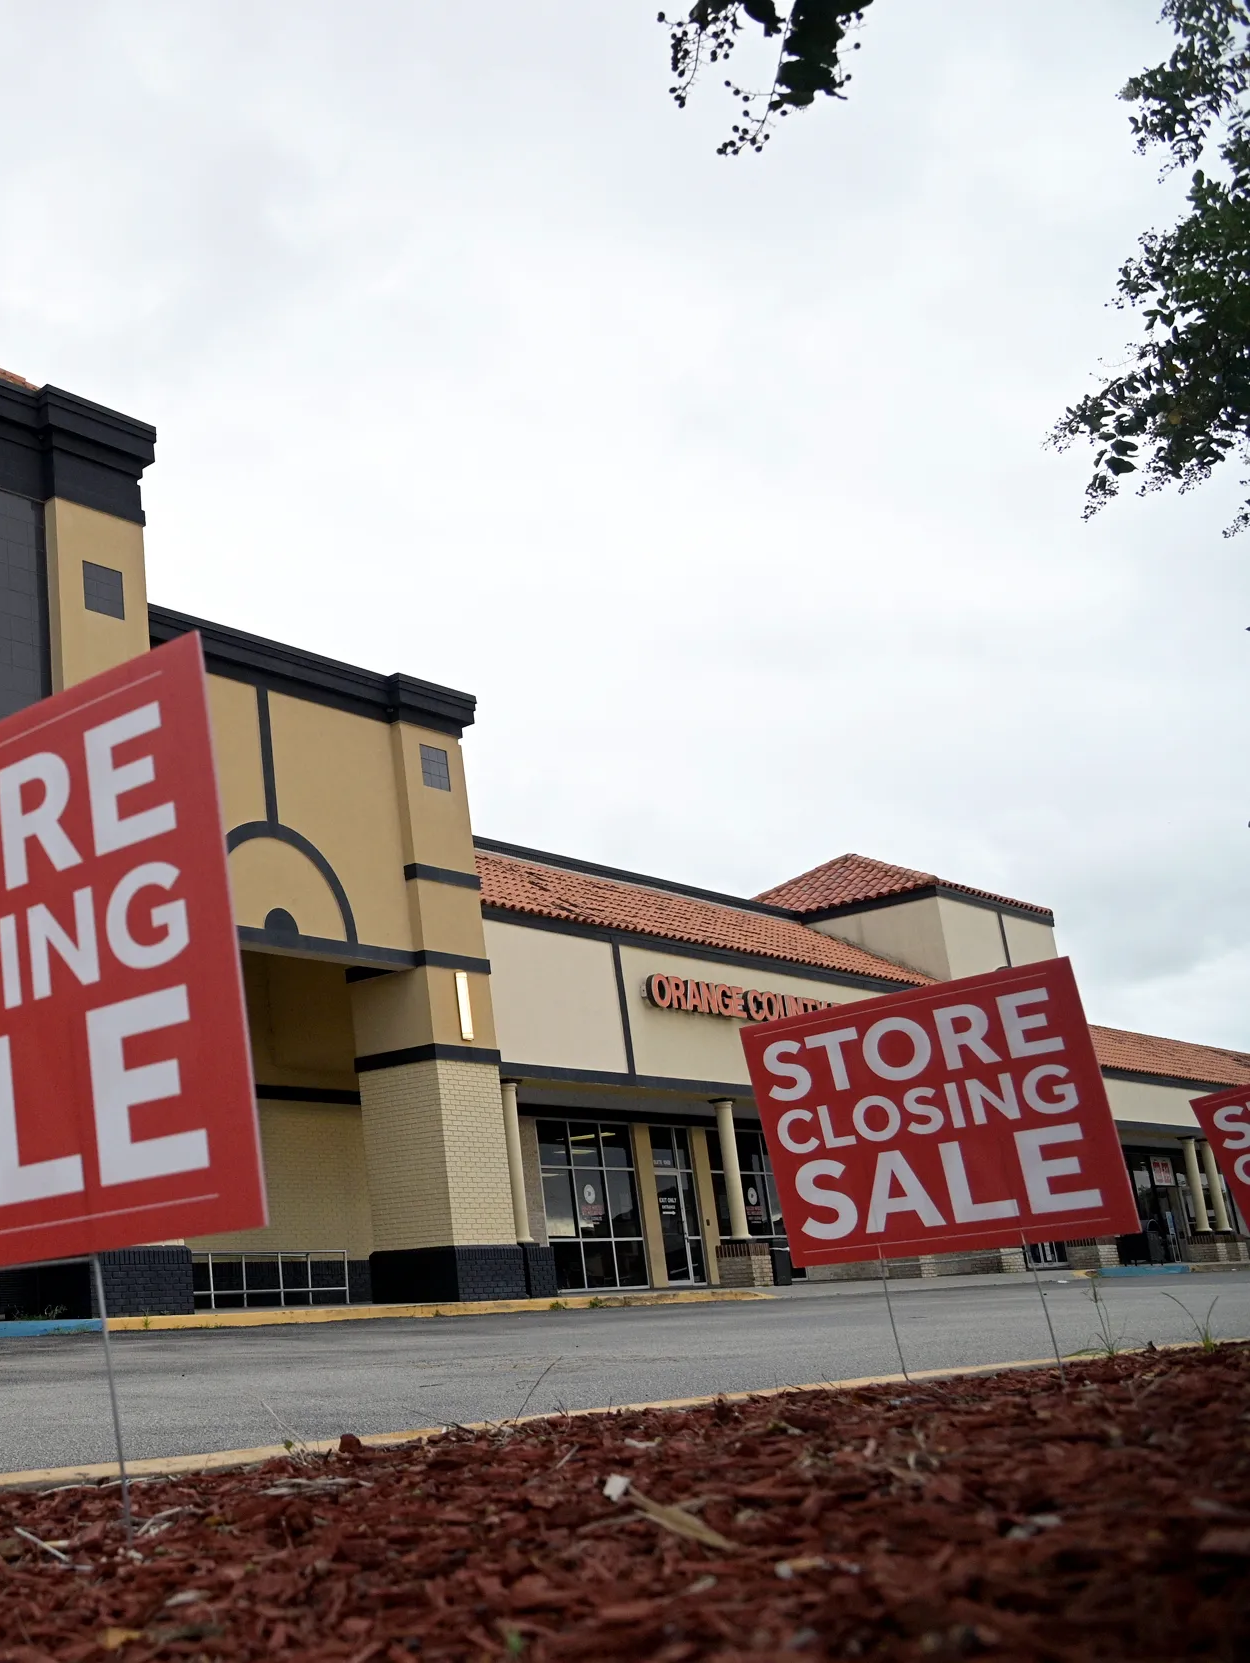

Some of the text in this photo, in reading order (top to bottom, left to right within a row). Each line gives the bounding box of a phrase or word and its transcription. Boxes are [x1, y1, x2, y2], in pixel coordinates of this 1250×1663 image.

[647, 973, 748, 1019] ORANGE
[762, 987, 1066, 1102] STORE
[777, 1065, 1079, 1154] CLOSING
[794, 1122, 1103, 1240] SALE
